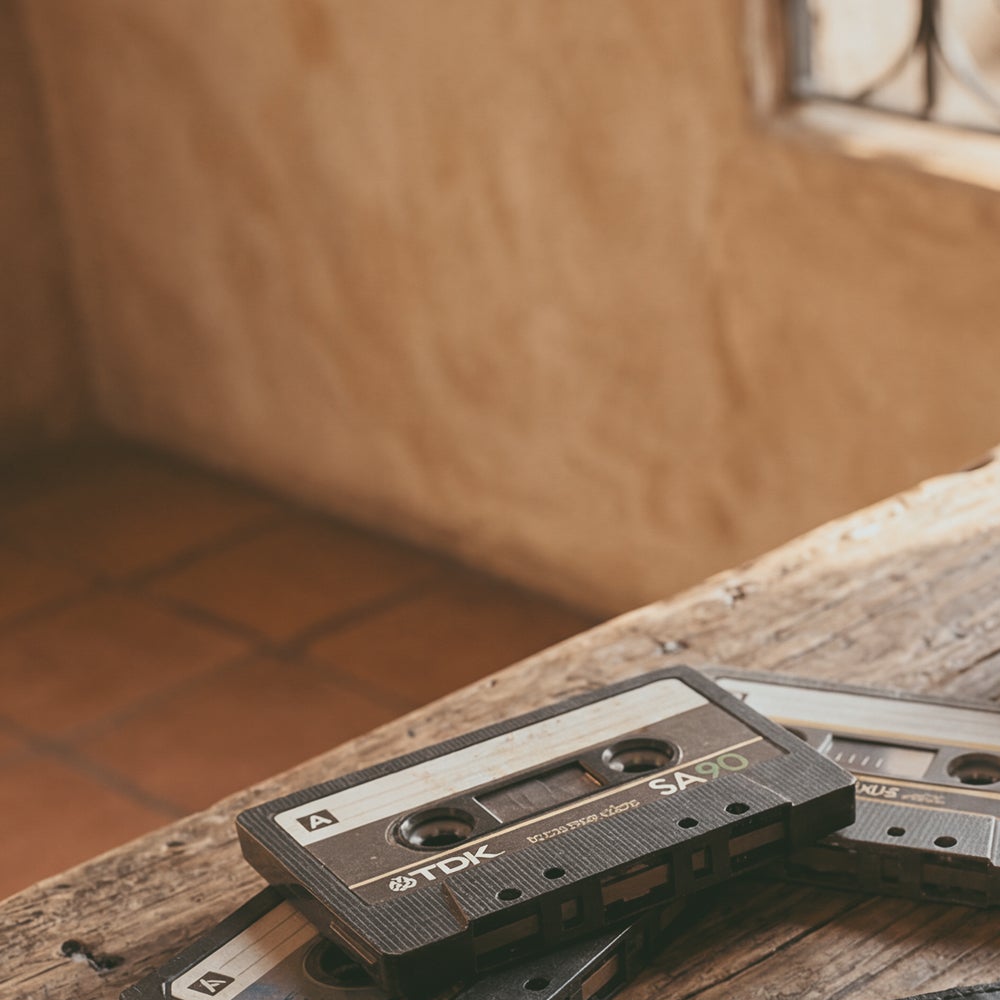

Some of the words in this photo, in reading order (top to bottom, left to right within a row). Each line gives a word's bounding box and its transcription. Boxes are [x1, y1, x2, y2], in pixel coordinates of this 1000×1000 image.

[648, 752, 749, 796] SA90
[307, 814, 333, 830] A
[407, 844, 506, 881] TDK
